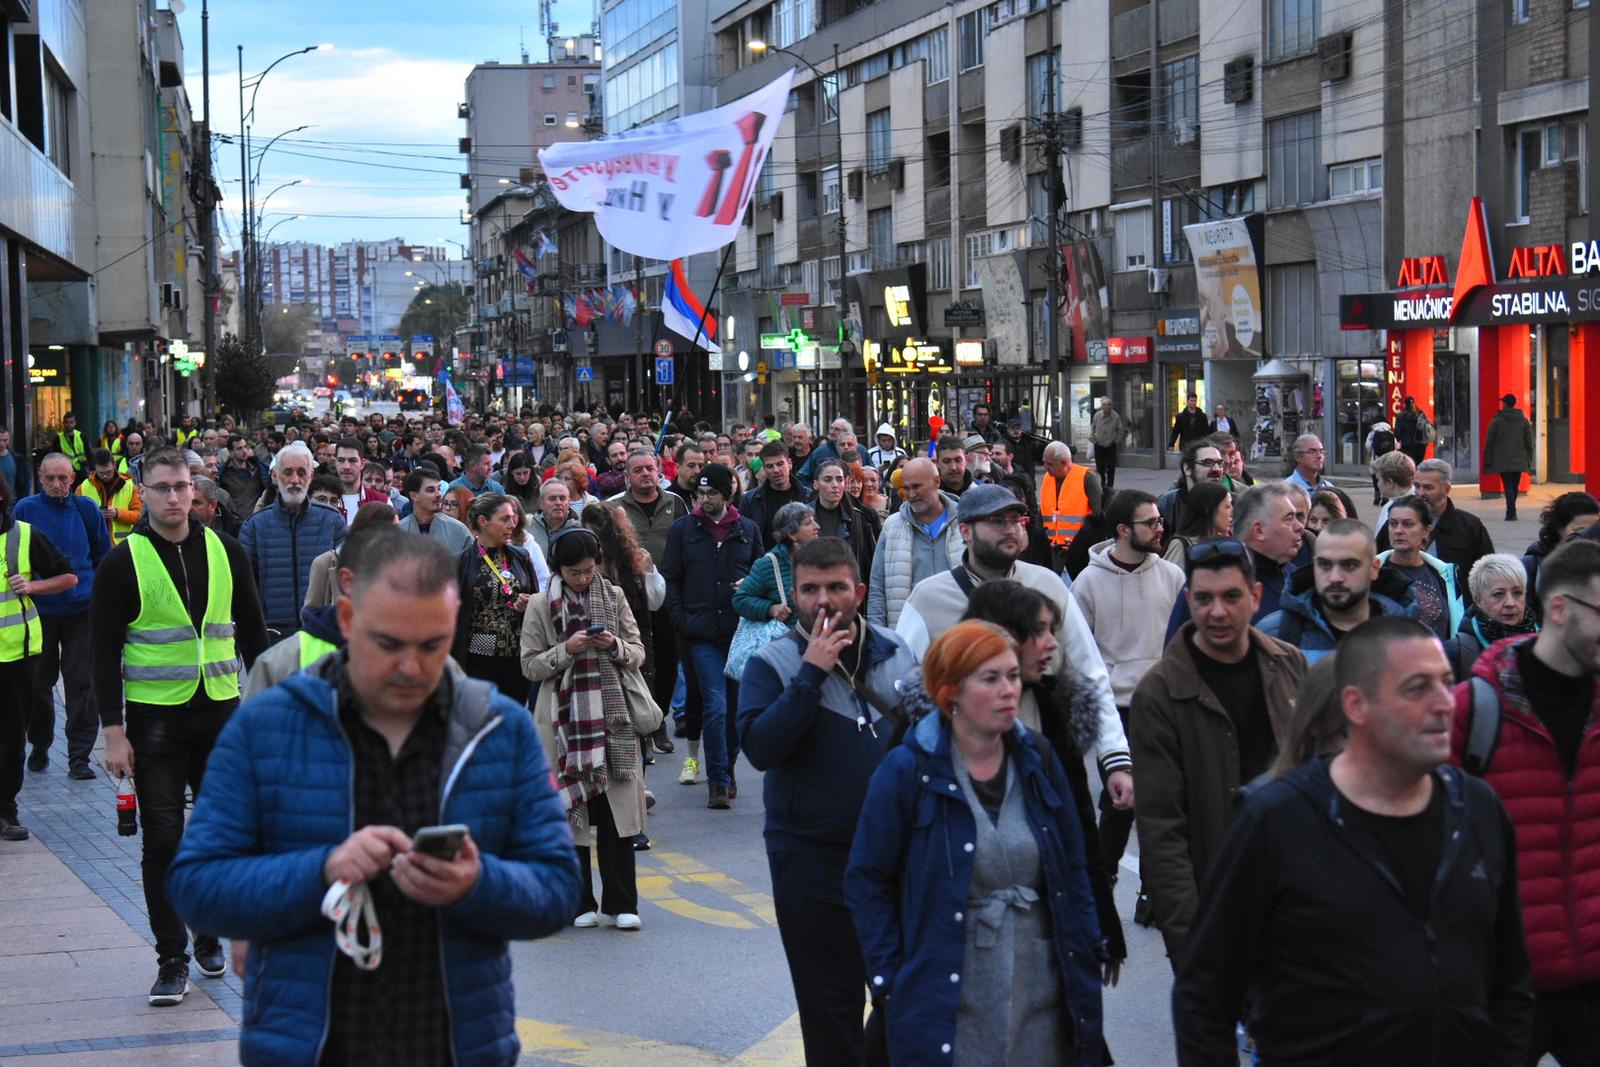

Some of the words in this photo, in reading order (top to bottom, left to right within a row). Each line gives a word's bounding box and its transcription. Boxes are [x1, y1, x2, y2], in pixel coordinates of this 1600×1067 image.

[1204, 226, 1234, 245] NEUROTH
[1397, 255, 1448, 287] ALTA
[1508, 243, 1567, 279] ALTA
[1571, 240, 1600, 275] BA
[1492, 290, 1570, 317] STABILNA,
[1577, 288, 1600, 312] SIG
[659, 344, 670, 353] 30
